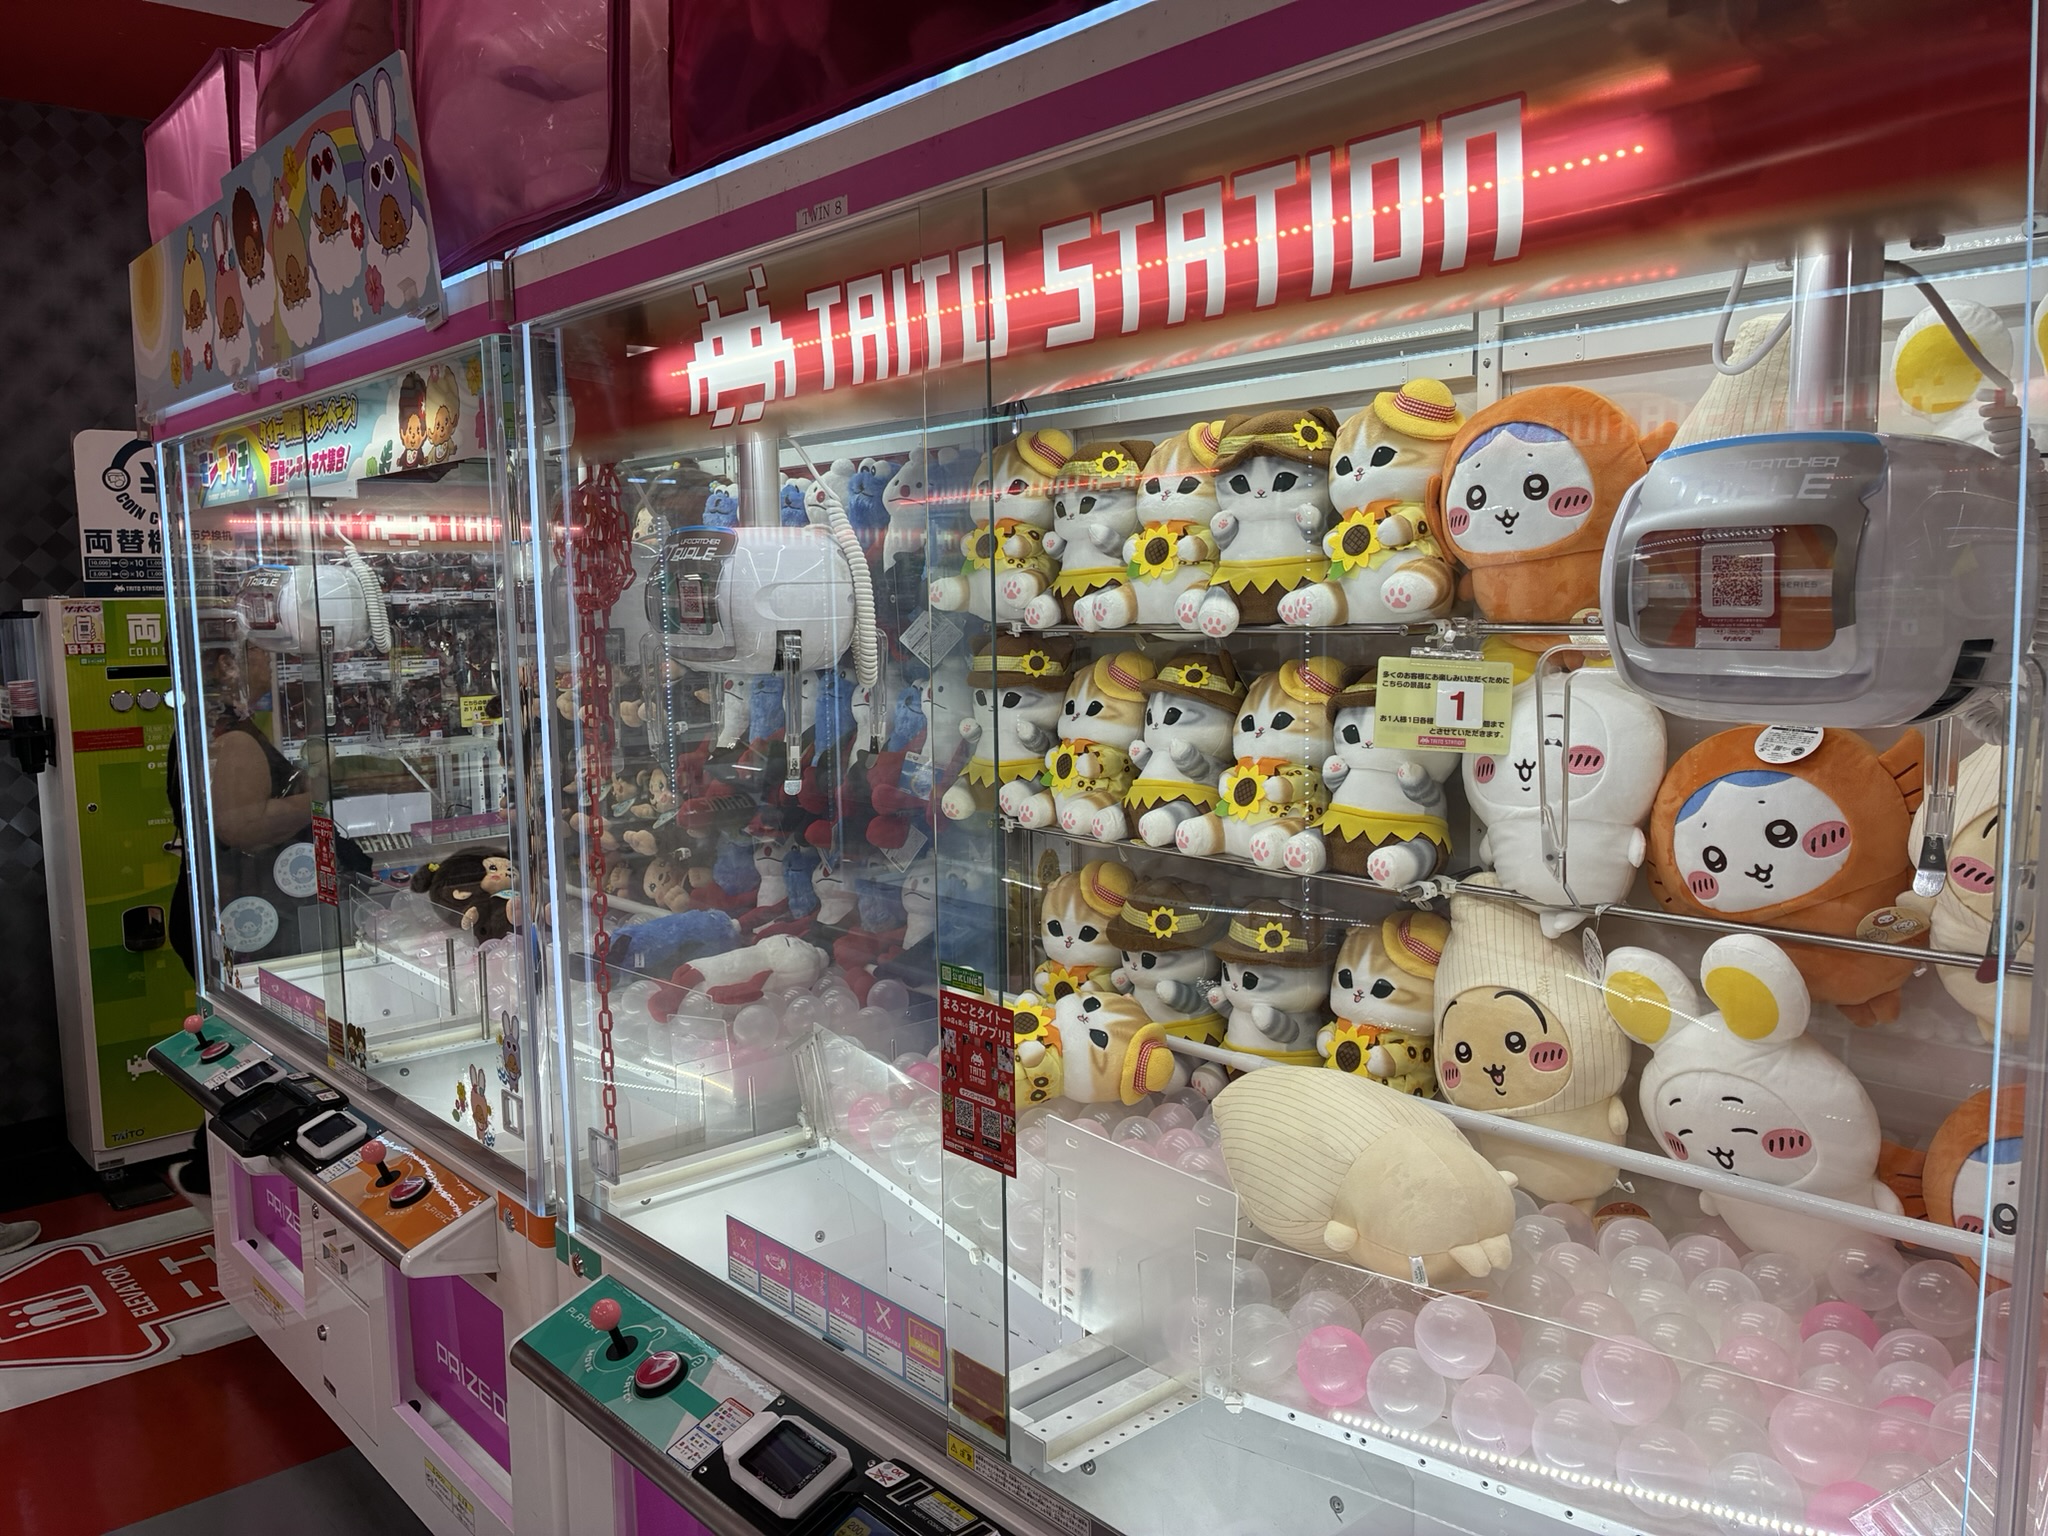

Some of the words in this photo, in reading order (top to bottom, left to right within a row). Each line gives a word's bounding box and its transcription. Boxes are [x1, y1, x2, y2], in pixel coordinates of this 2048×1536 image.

[802, 203, 830, 225] TWIN
[834, 200, 842, 215] 8
[806, 239, 1008, 391] TAITO
[1042, 98, 1524, 349] STATION
[116, 492, 146, 520] COIN
[126, 613, 162, 645] 両
[1382, 670, 1510, 684] 多くのお客様にお楽しみいただくために
[1382, 680, 1431, 689] こちらの景品は
[1449, 690, 1465, 721] 1
[1429, 728, 1504, 738] とさせていただきます。
[1482, 720, 1505, 729] 個まで
[943, 996, 1011, 1025] まるごとタイトー
[968, 1019, 1005, 1043] 新アプリ
[969, 1065, 987, 1079] TAITO
[111, 1129, 145, 1142] TAITO
[421, 1202, 446, 1221] PLAYER
[101, 1264, 160, 1319] ELEVATOR
[565, 1306, 595, 1332] PLAYER
[583, 1349, 595, 1374] MOVE
